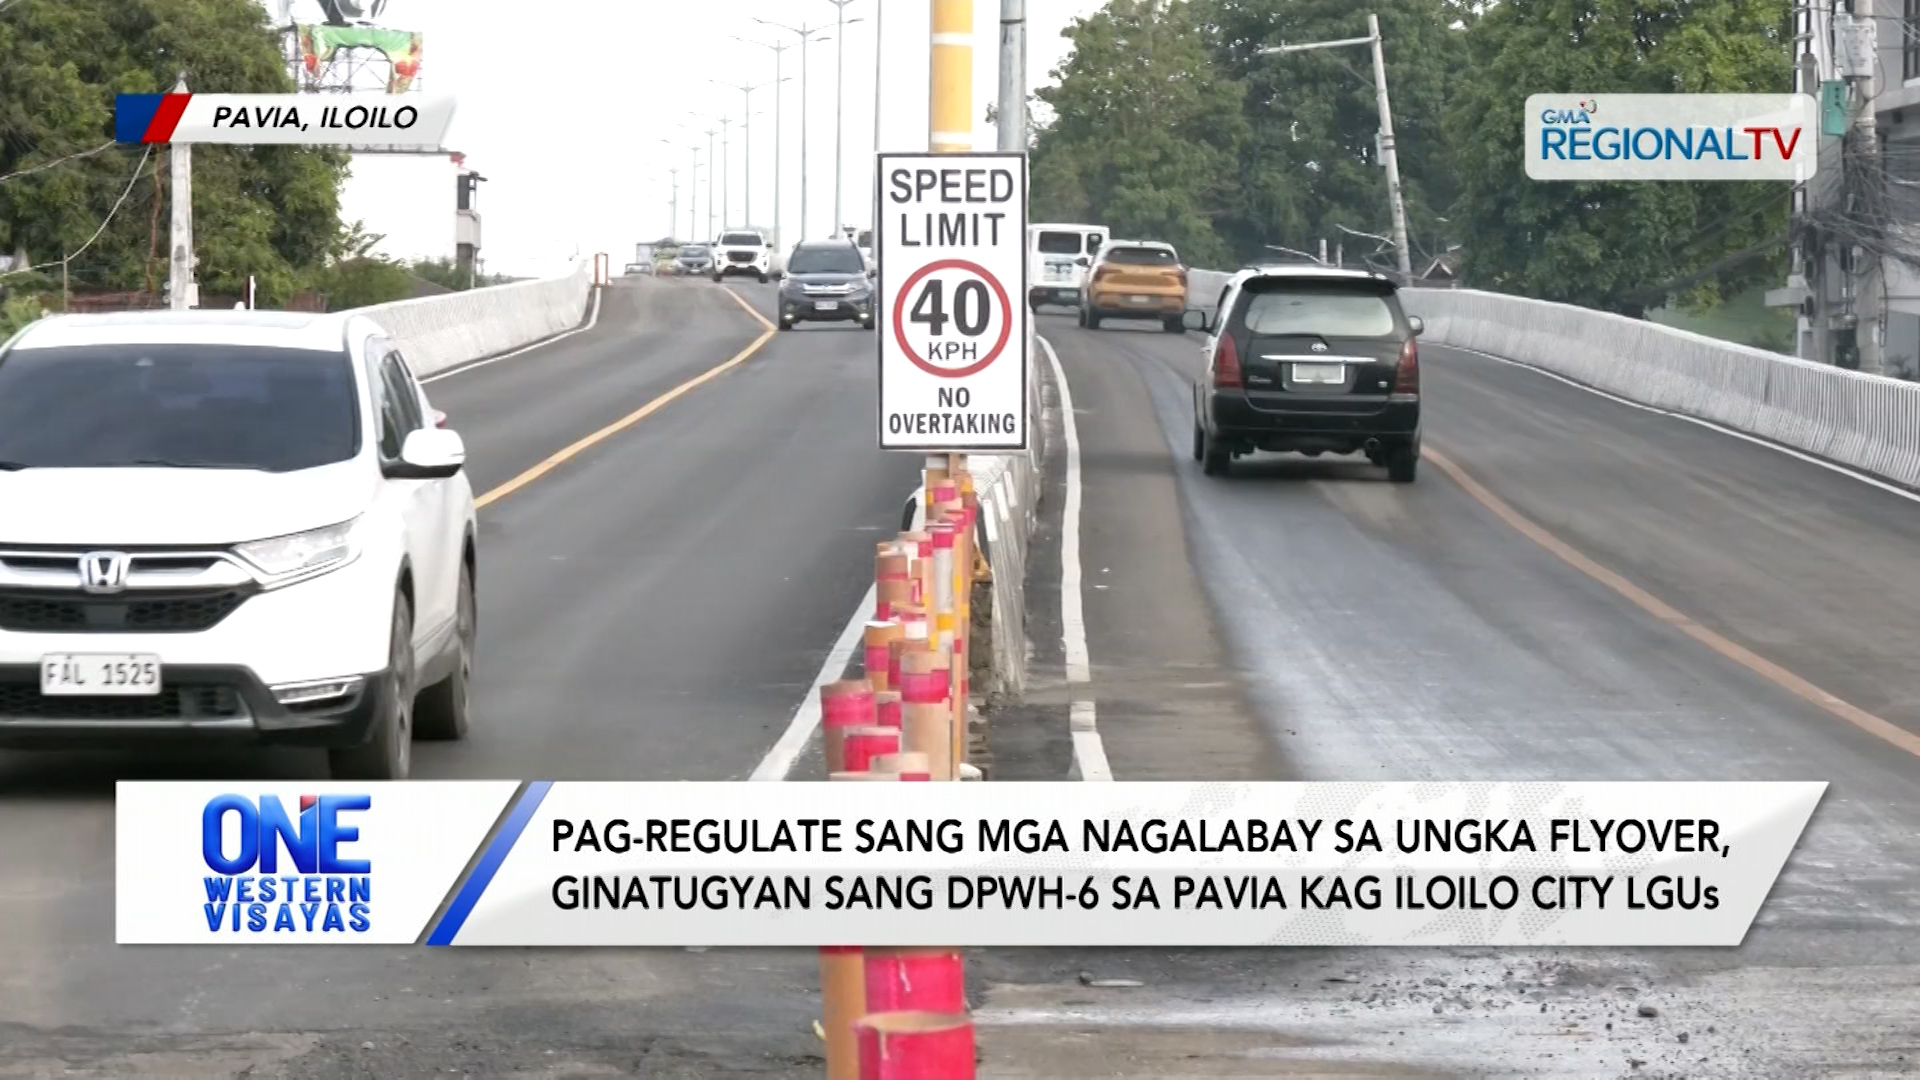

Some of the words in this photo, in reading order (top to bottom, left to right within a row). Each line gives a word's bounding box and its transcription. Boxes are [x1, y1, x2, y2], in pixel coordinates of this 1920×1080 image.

[889, 168, 1014, 203] SPEED
[900, 212, 1006, 247] LIMIT
[909, 278, 991, 337] 40
[927, 342, 978, 362] KPH
[937, 386, 971, 409] NO
[888, 412, 1016, 435] OVERTAKING
[46, 663, 85, 686] FAL
[102, 662, 157, 686] 1525
